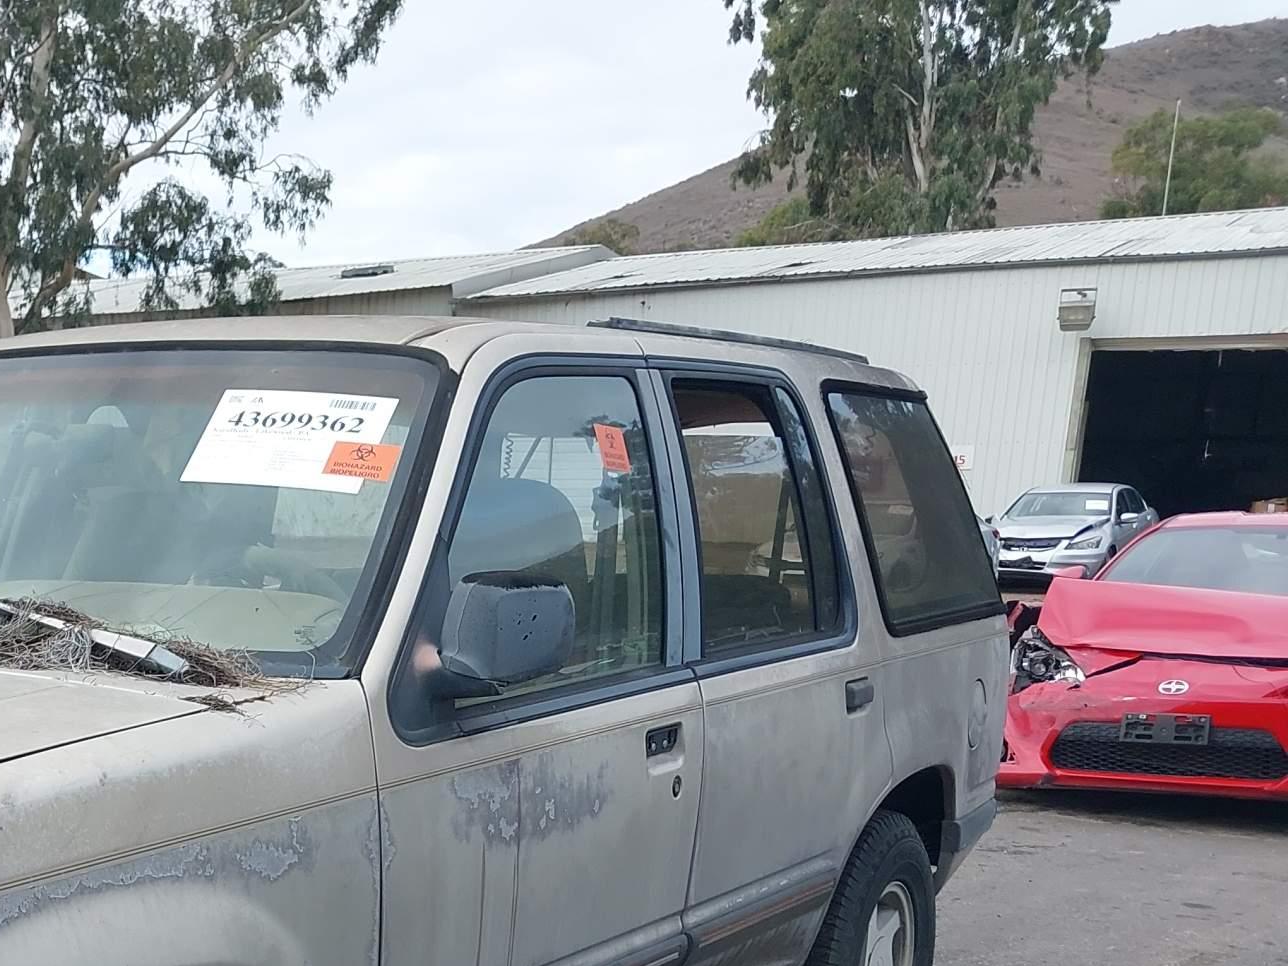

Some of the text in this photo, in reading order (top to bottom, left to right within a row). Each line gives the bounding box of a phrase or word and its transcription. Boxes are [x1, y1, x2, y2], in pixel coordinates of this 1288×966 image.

[228, 410, 365, 434] 43699362
[333, 461, 383, 472] BIOHAZARD
[329, 468, 380, 479] BIOPELIGRO
